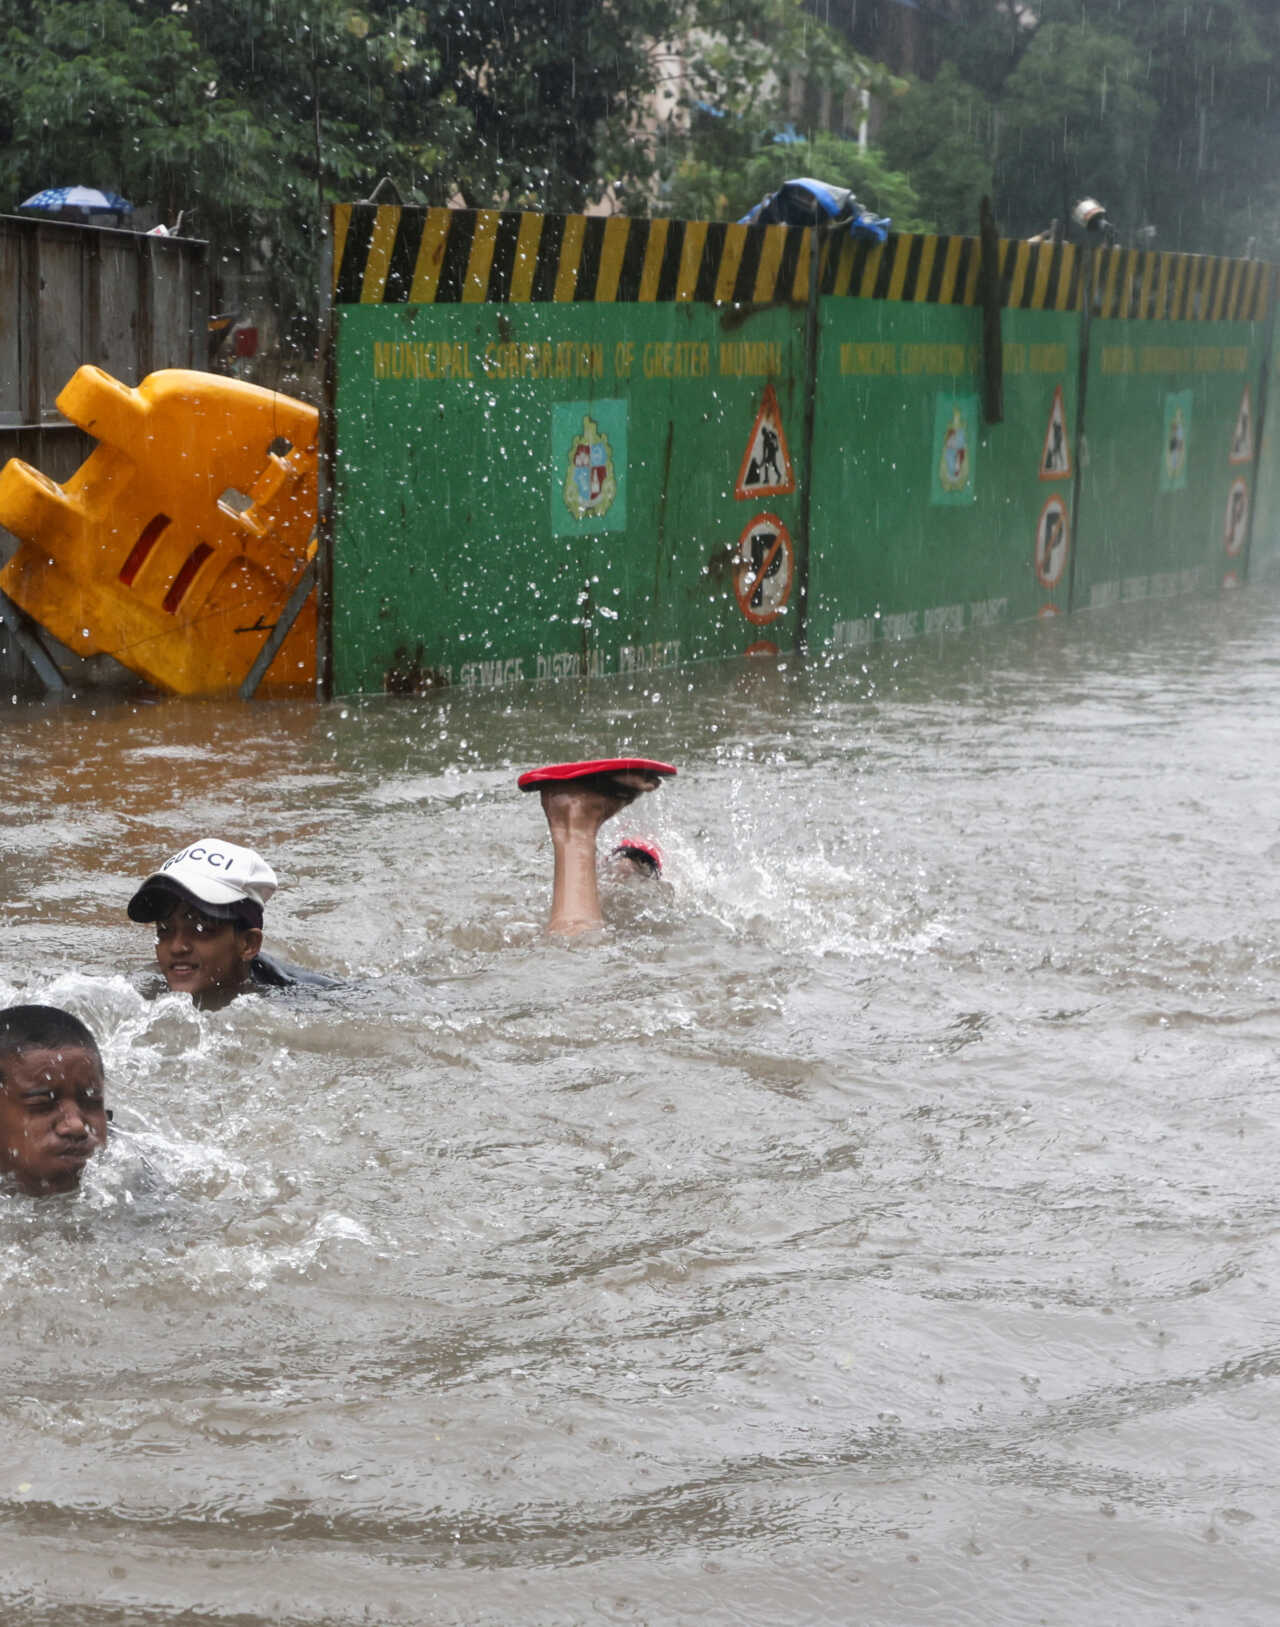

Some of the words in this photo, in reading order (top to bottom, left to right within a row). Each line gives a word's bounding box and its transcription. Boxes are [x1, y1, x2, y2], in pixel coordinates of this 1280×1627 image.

[374, 342, 472, 379] MUNICIPAL
[615, 342, 635, 378] OF
[643, 342, 710, 379] GREATER
[163, 848, 233, 871] GUCCI
